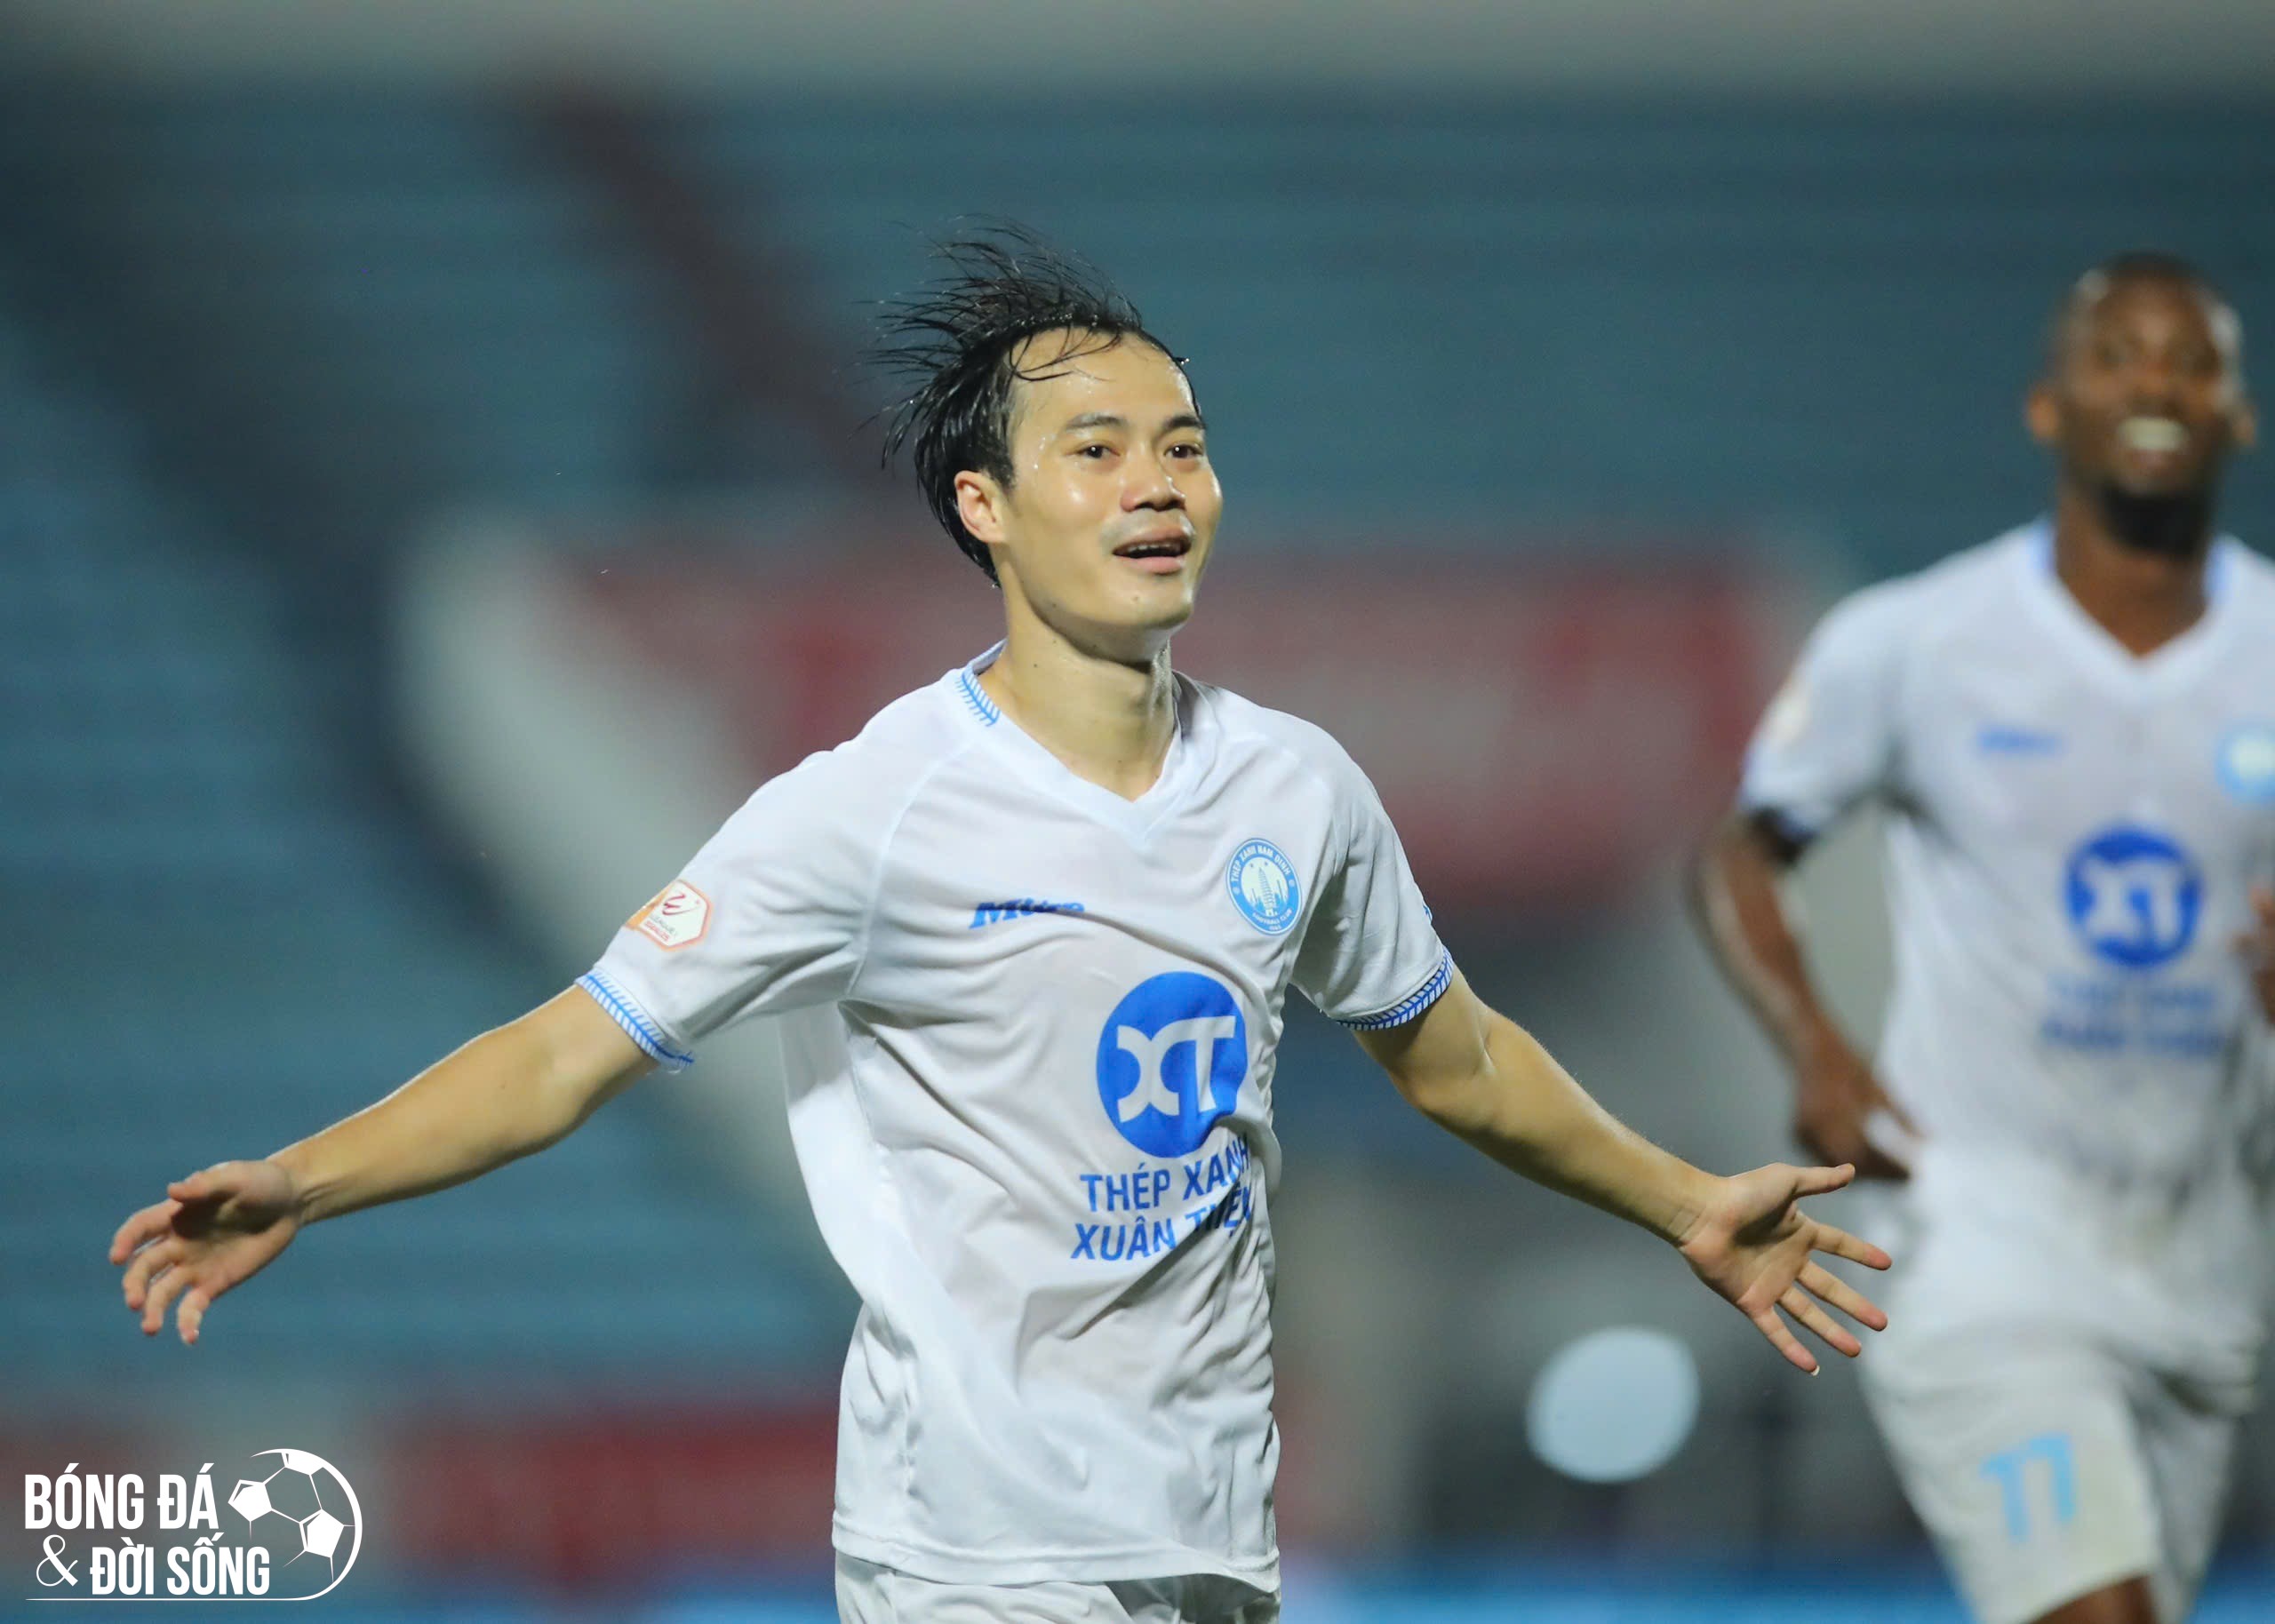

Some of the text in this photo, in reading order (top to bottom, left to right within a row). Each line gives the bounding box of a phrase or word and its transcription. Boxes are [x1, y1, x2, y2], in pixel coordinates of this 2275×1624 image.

[1080, 1134, 1251, 1213] THÉP XANH
[1070, 1215, 1177, 1262] XUÂN
[1978, 1431, 2077, 1542] 17
